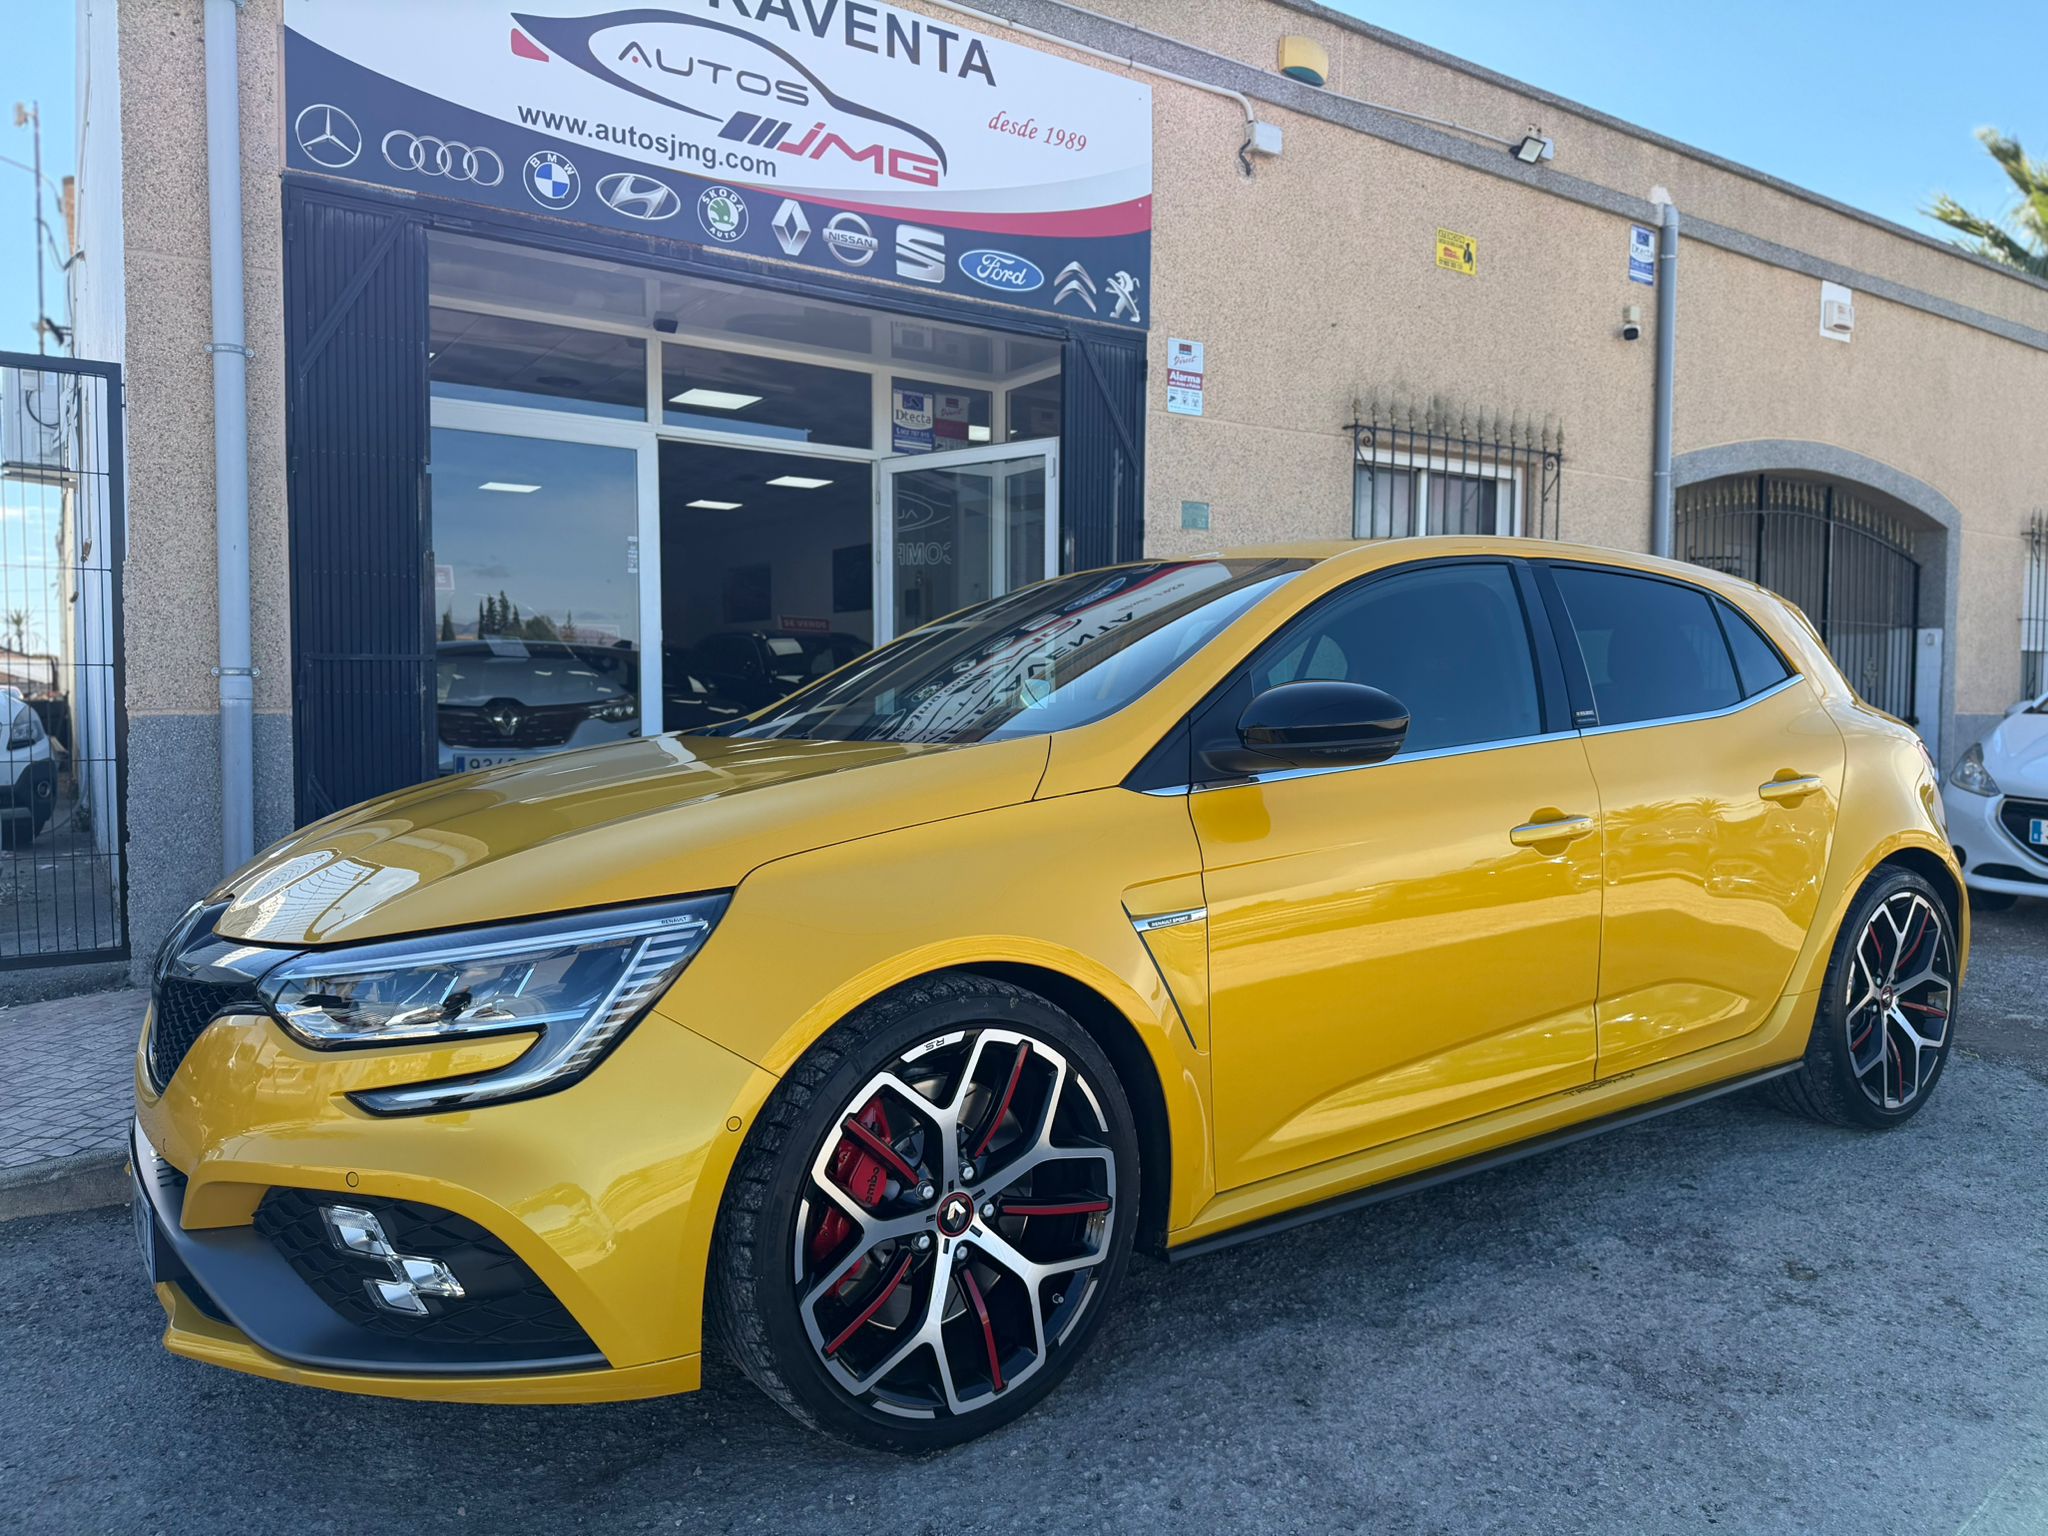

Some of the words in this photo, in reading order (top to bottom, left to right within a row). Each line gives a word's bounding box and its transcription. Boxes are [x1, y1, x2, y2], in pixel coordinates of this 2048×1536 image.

[618, 41, 809, 107] AUTOS
[988, 110, 1038, 139] desde
[1043, 127, 1087, 152] 1989
[517, 105, 777, 178] www.autosjmg.com
[529, 153, 576, 176] BMW
[709, 226, 738, 240] AUTO
[828, 231, 874, 248] NISSAN
[976, 253, 1027, 286] Ford
[1169, 371, 1201, 384] Alarma
[895, 408, 932, 425] Dtecta
[660, 916, 688, 924] RENAULT
